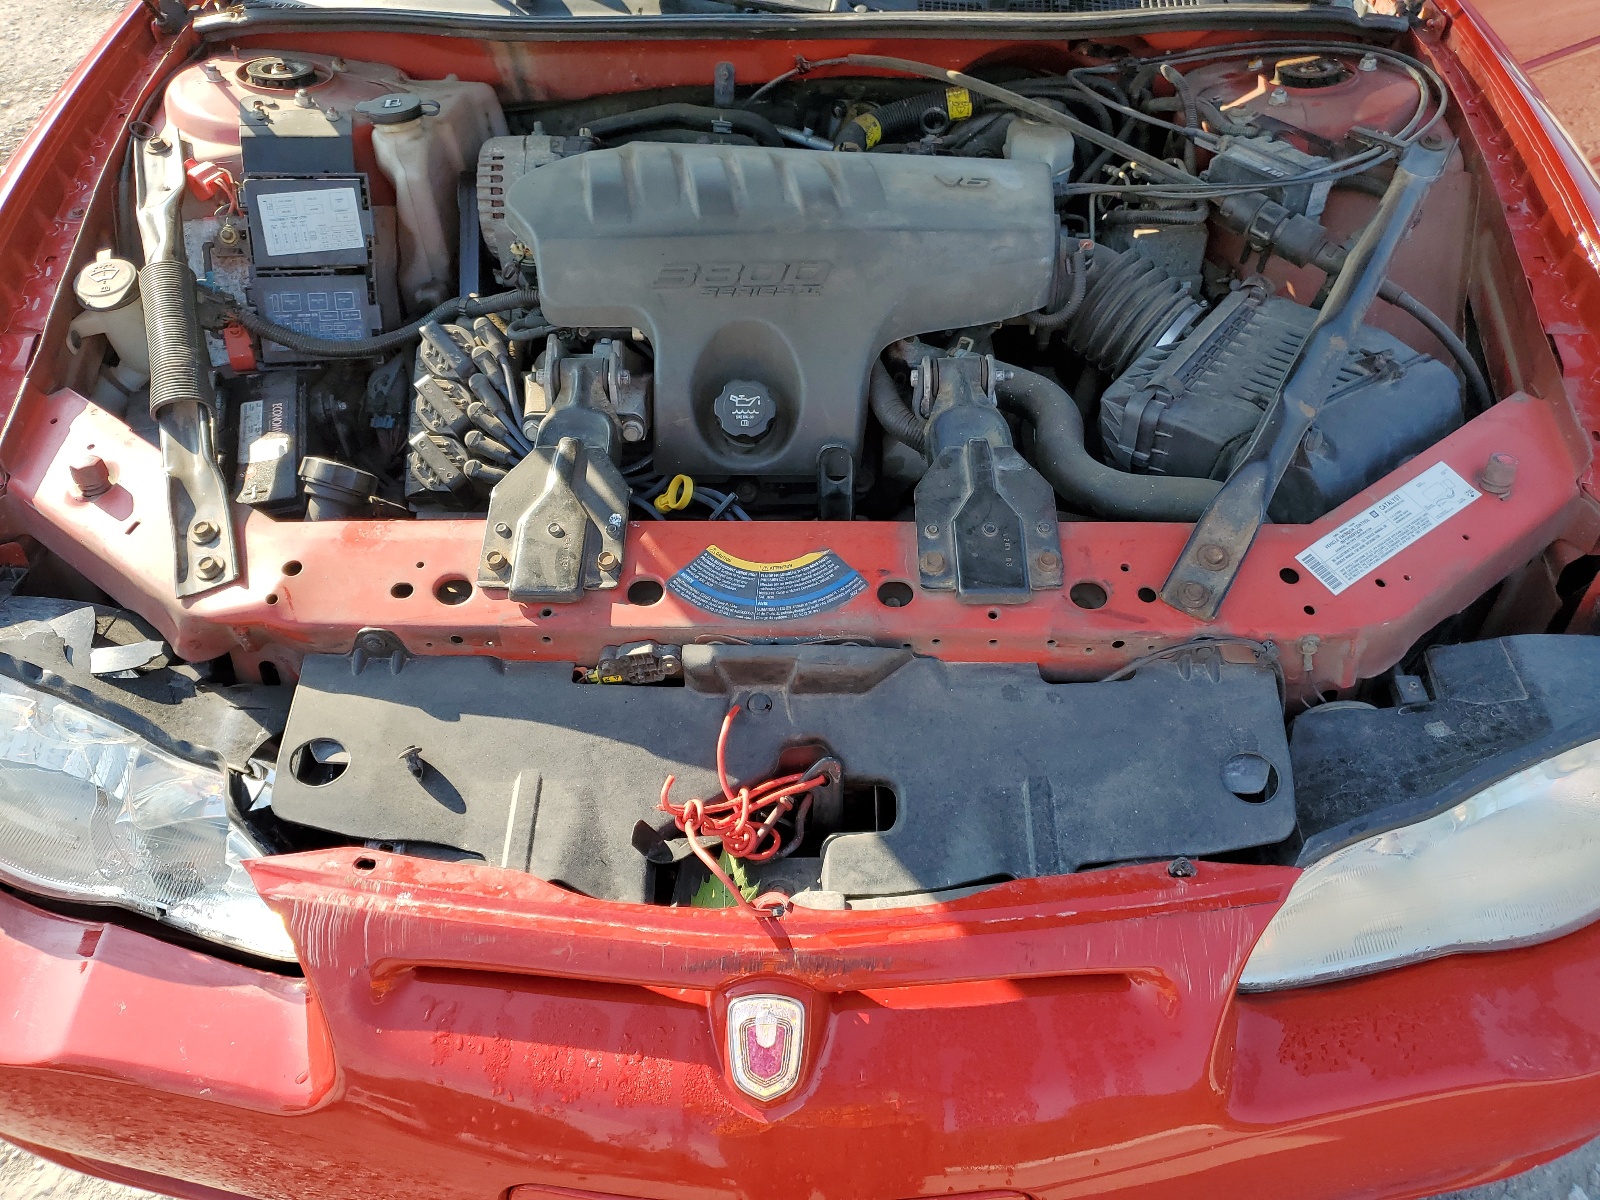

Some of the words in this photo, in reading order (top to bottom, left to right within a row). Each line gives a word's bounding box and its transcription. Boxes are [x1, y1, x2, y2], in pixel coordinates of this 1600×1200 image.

[933, 175, 991, 189] V6
[651, 261, 835, 289] 3800
[702, 286, 796, 297] SERIES
[271, 402, 283, 434] ECONOMY
[1377, 493, 1402, 511] CATALYST
